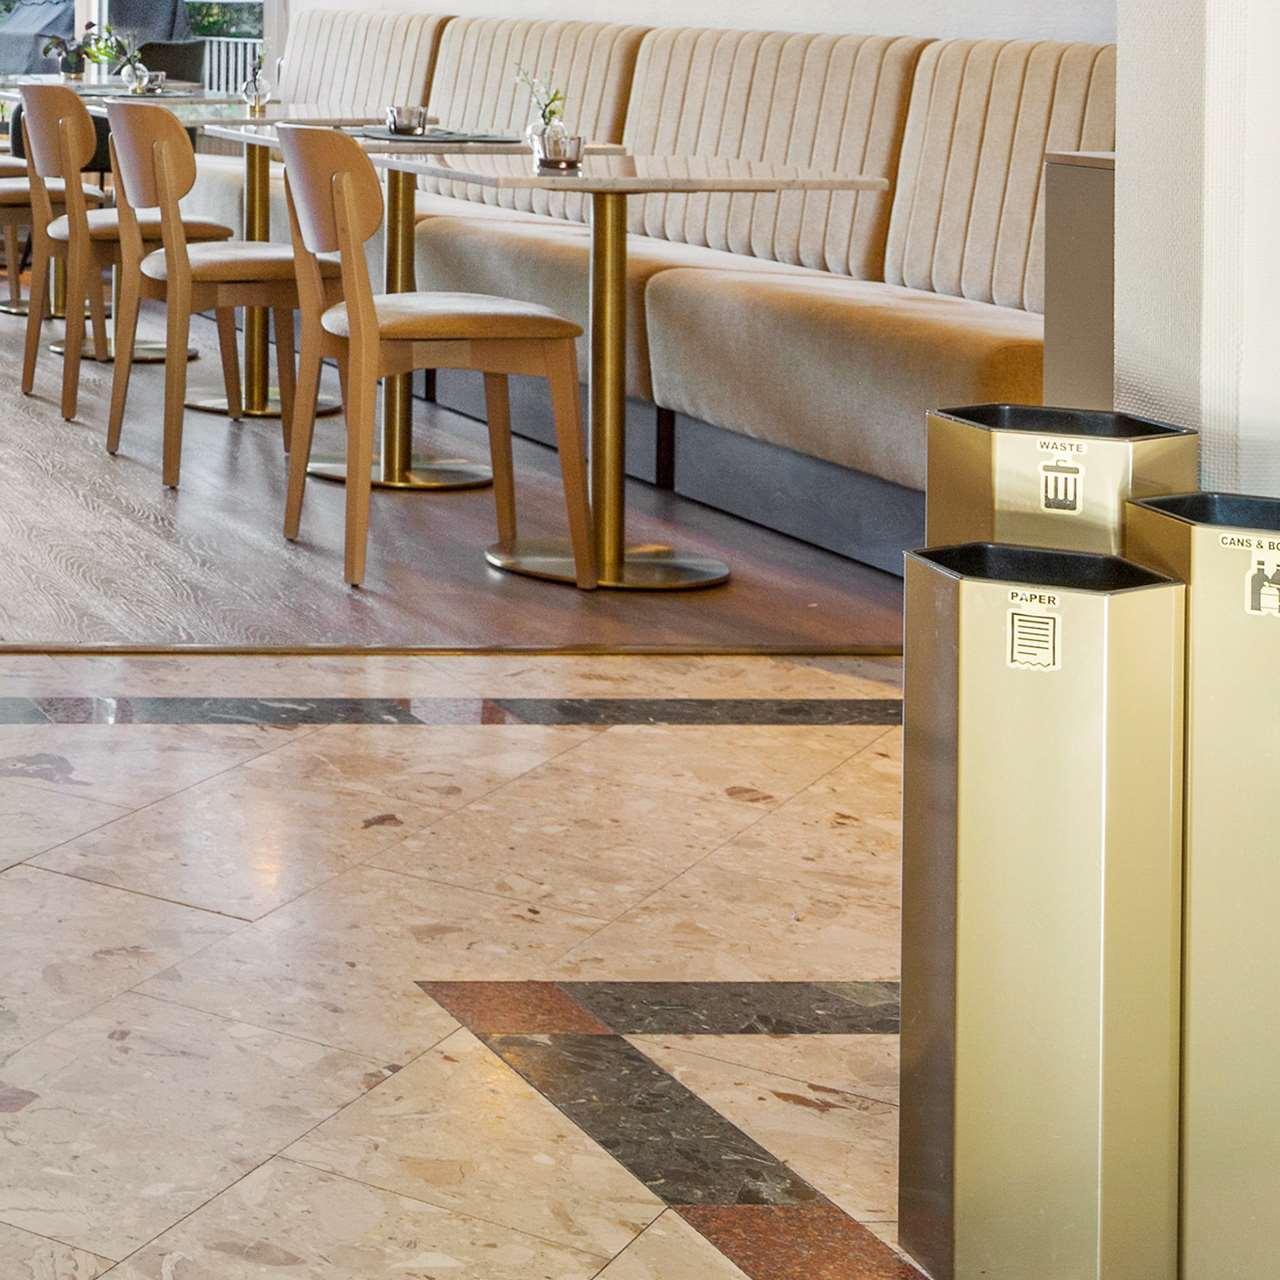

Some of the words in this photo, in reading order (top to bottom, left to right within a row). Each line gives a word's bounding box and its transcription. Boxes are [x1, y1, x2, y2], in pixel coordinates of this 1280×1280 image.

[1040, 441, 1083, 452] WASTE
[1221, 536, 1252, 548] CANS
[1256, 539, 1263, 549] &
[1011, 591, 1056, 605] PAPER
